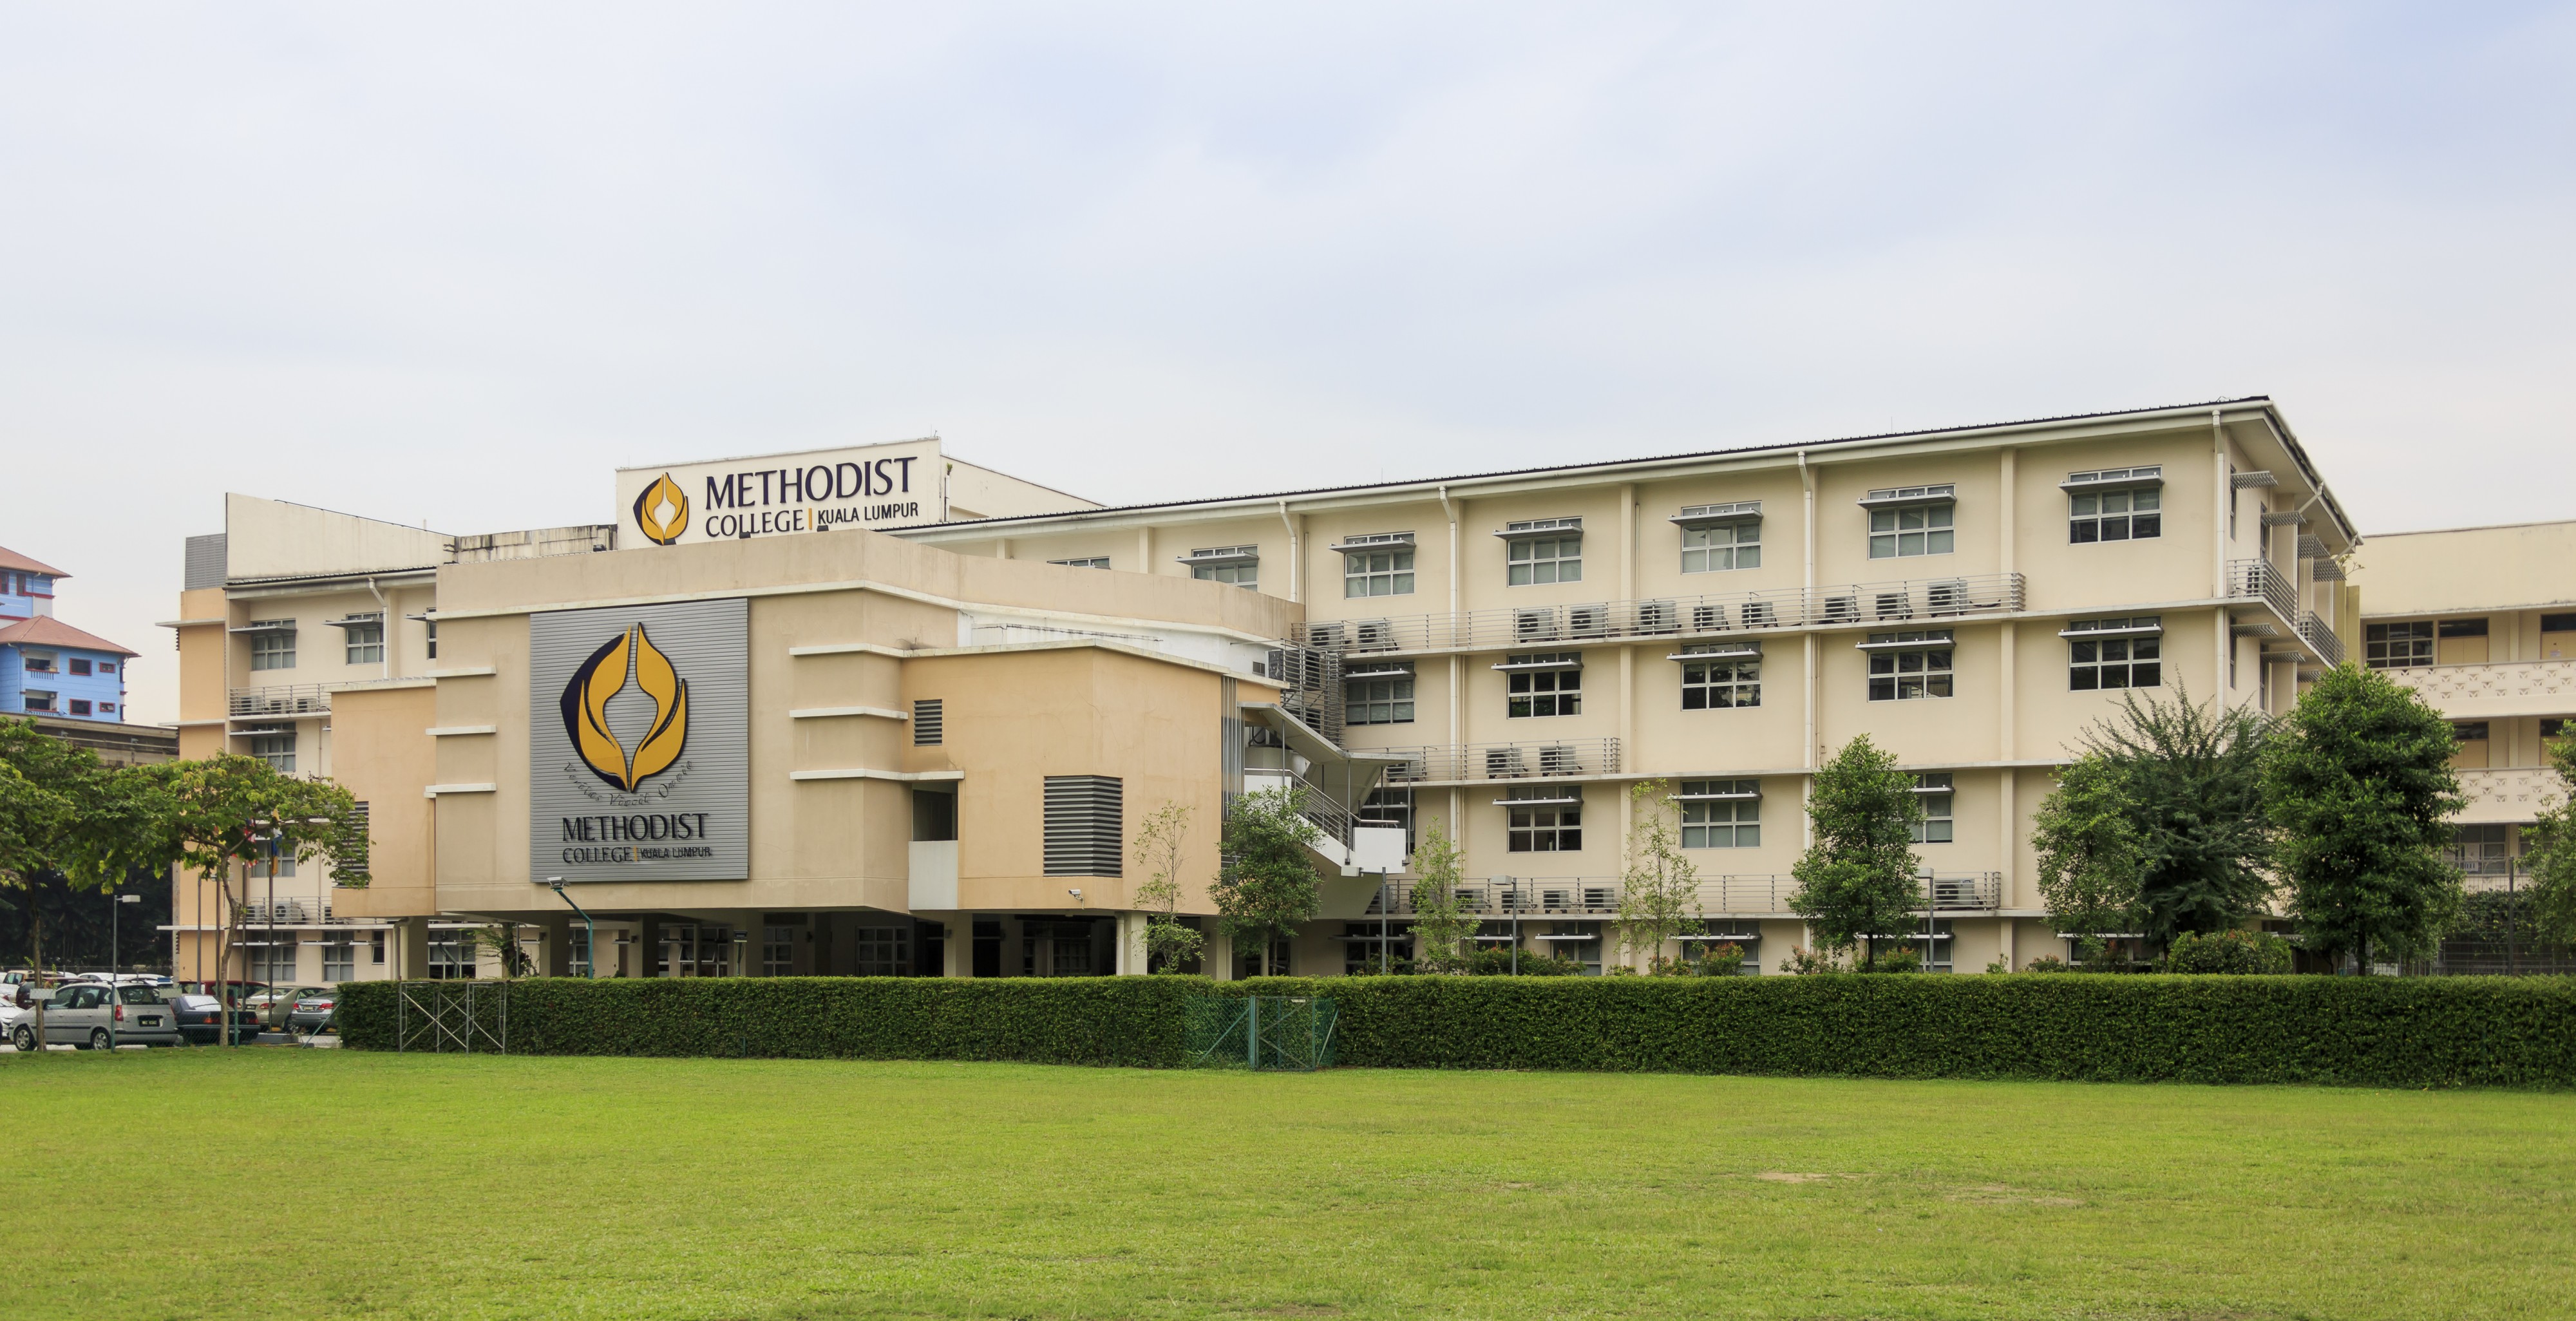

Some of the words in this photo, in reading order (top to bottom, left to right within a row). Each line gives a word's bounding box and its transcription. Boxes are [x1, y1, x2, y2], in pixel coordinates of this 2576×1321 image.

[705, 456, 918, 510] METHODIST
[705, 509, 805, 537] COLLEGE
[817, 506, 860, 525] KUALA
[864, 502, 919, 520] LUMPUR
[562, 813, 709, 841] METHODIST
[563, 846, 634, 863] COLLEGE
[640, 847, 670, 859] KUALA
[672, 846, 713, 859] LUMPUR
